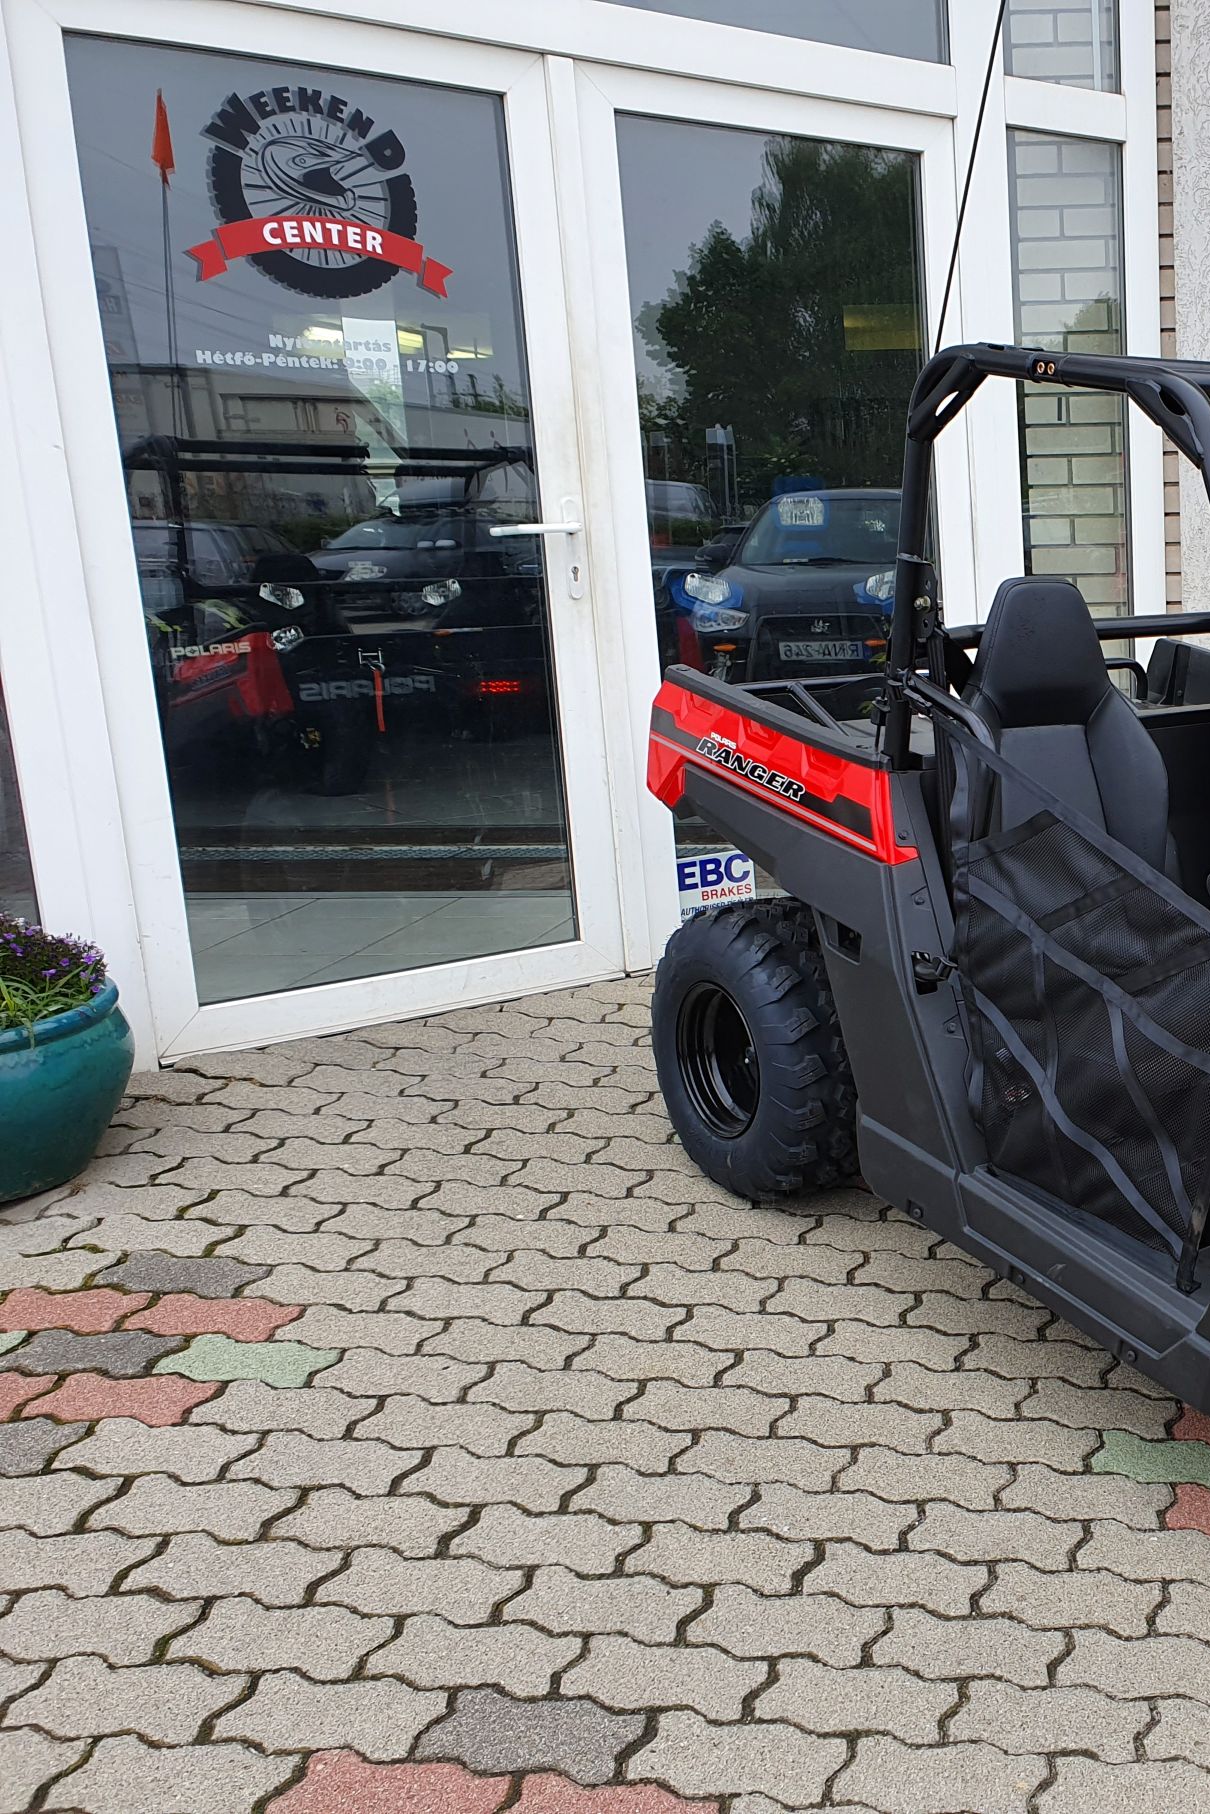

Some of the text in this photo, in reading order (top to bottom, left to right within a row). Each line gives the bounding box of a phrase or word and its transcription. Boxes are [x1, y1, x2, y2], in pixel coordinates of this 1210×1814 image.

[203, 86, 406, 171] WEEKEND
[262, 222, 384, 254] CENTER
[406, 359, 459, 373] 17:00
[170, 641, 251, 659] POLARIS
[696, 736, 806, 801] RANGER
[677, 853, 750, 892] EBC
[701, 883, 752, 901] BRAKES
